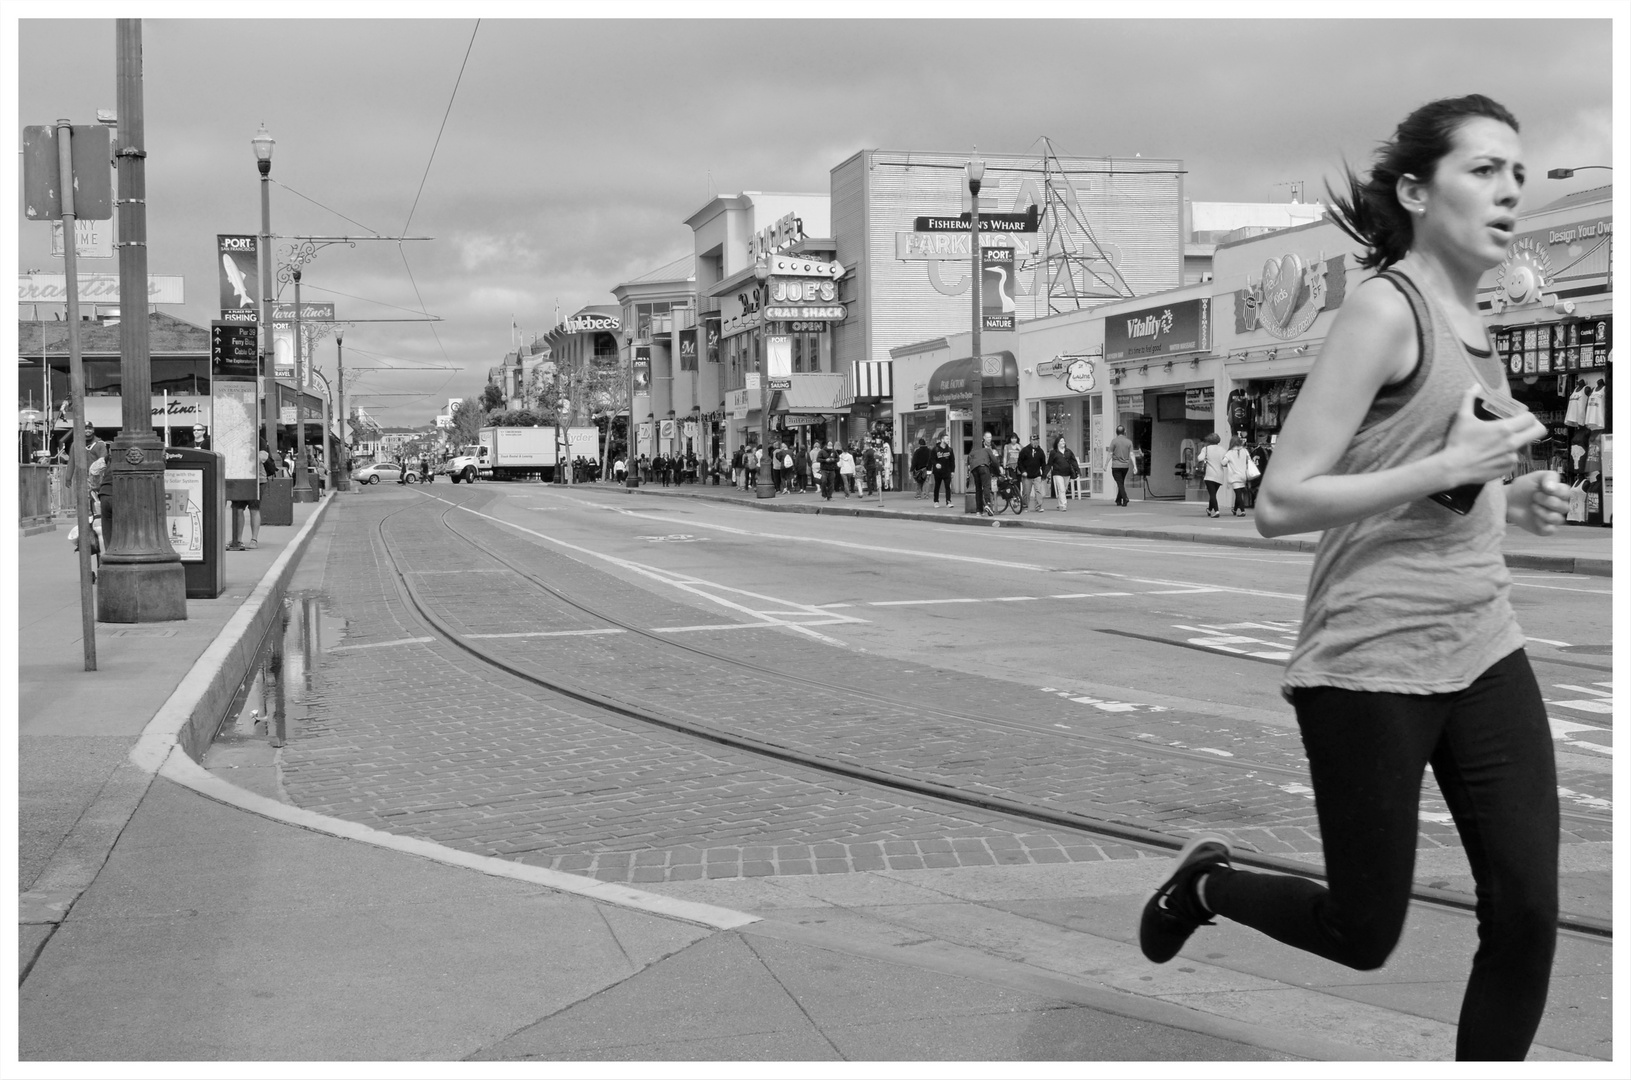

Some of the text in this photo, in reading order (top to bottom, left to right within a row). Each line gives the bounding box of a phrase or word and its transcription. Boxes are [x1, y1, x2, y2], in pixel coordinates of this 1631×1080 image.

[962, 177, 1091, 233] EAT
[990, 220, 1026, 231] WHARF
[75, 233, 98, 245] IME
[1549, 229, 1576, 243] Design
[1577, 224, 1596, 237] Your
[224, 238, 251, 248] PORT
[905, 232, 1007, 254] PARKING
[987, 250, 1009, 259] PORT
[773, 281, 834, 301] JOE'S
[272, 303, 333, 319] Taratino's
[766, 307, 843, 318] CRAB SHACK
[563, 314, 620, 335] Applebee's
[791, 321, 823, 332] OPEN
[986, 320, 1012, 328] NATURE
[1127, 315, 1161, 340] Vitality
[239, 328, 257, 336] Pier 39
[231, 338, 244, 346] Ferry
